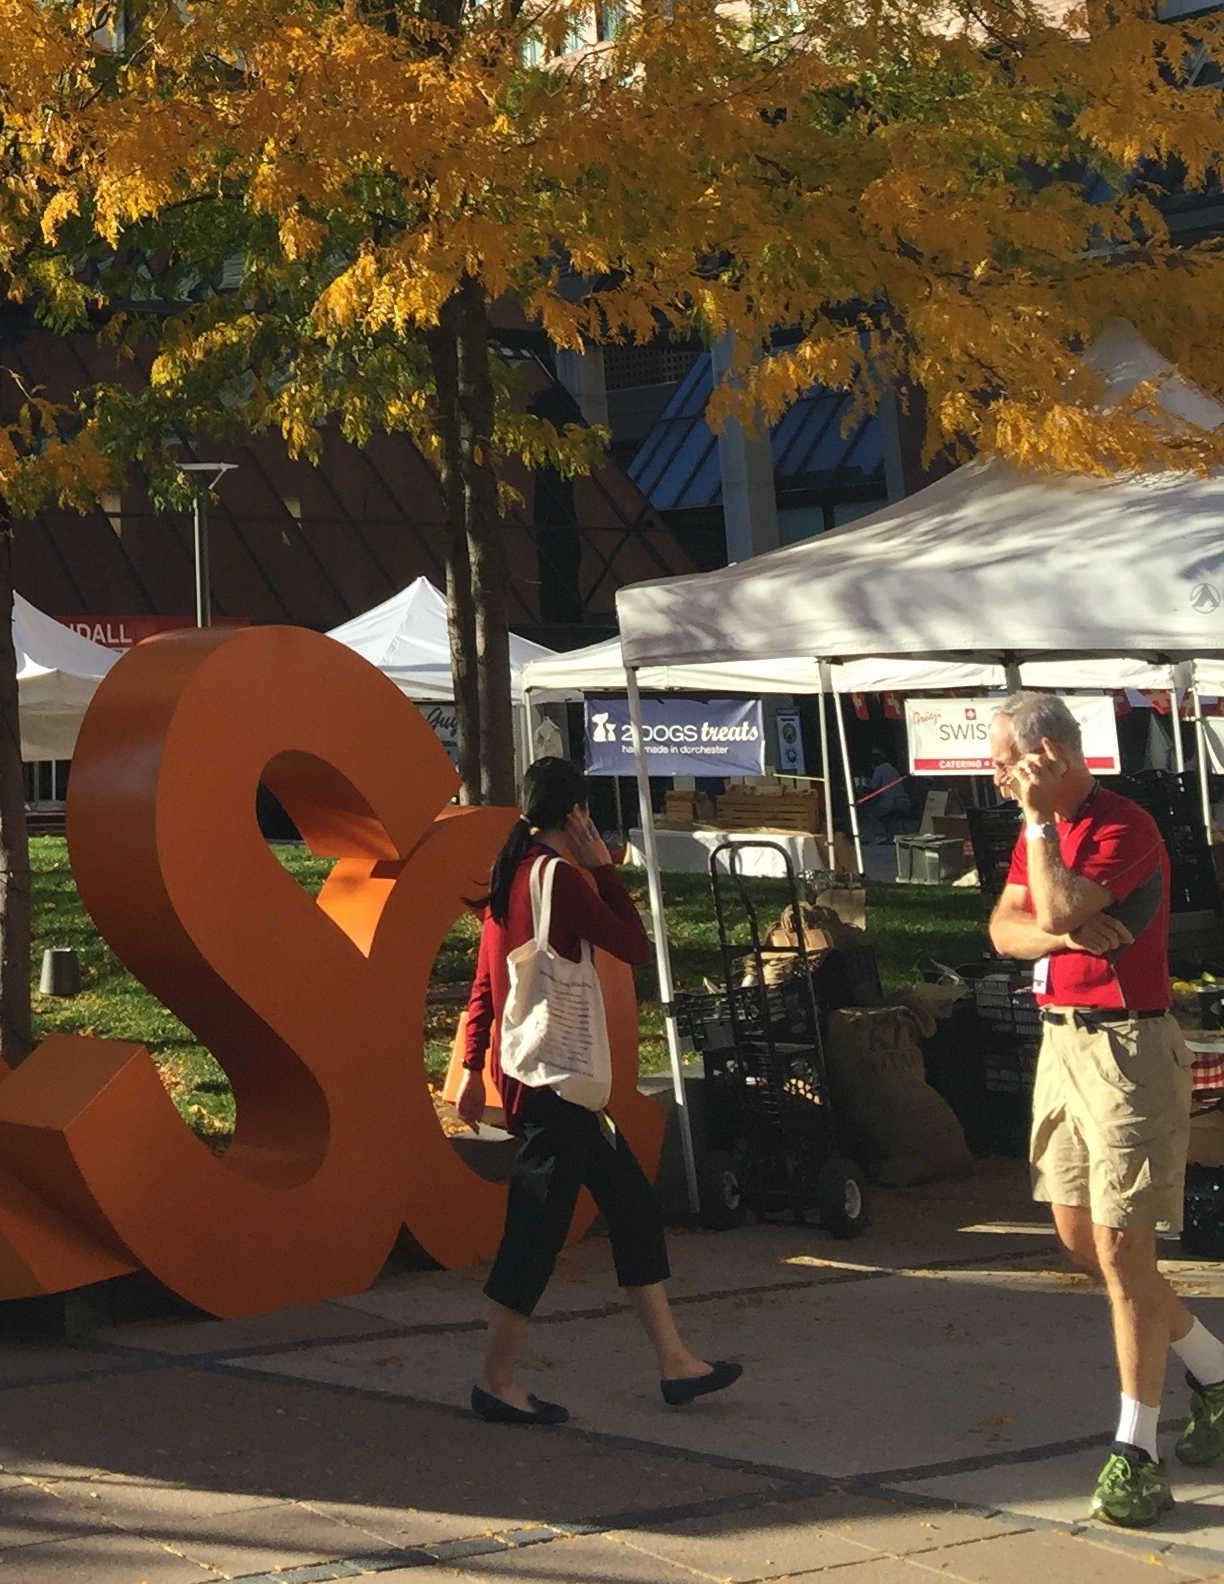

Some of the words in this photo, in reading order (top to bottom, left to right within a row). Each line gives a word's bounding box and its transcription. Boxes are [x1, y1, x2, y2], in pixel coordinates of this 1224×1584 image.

[68, 623, 133, 643] DALL
[621, 724, 633, 741] 2
[701, 721, 759, 742] treats
[939, 723, 991, 741] SWIS
[670, 745, 679, 753] in
[680, 745, 729, 754] dorchester
[939, 760, 982, 769] CATERING
